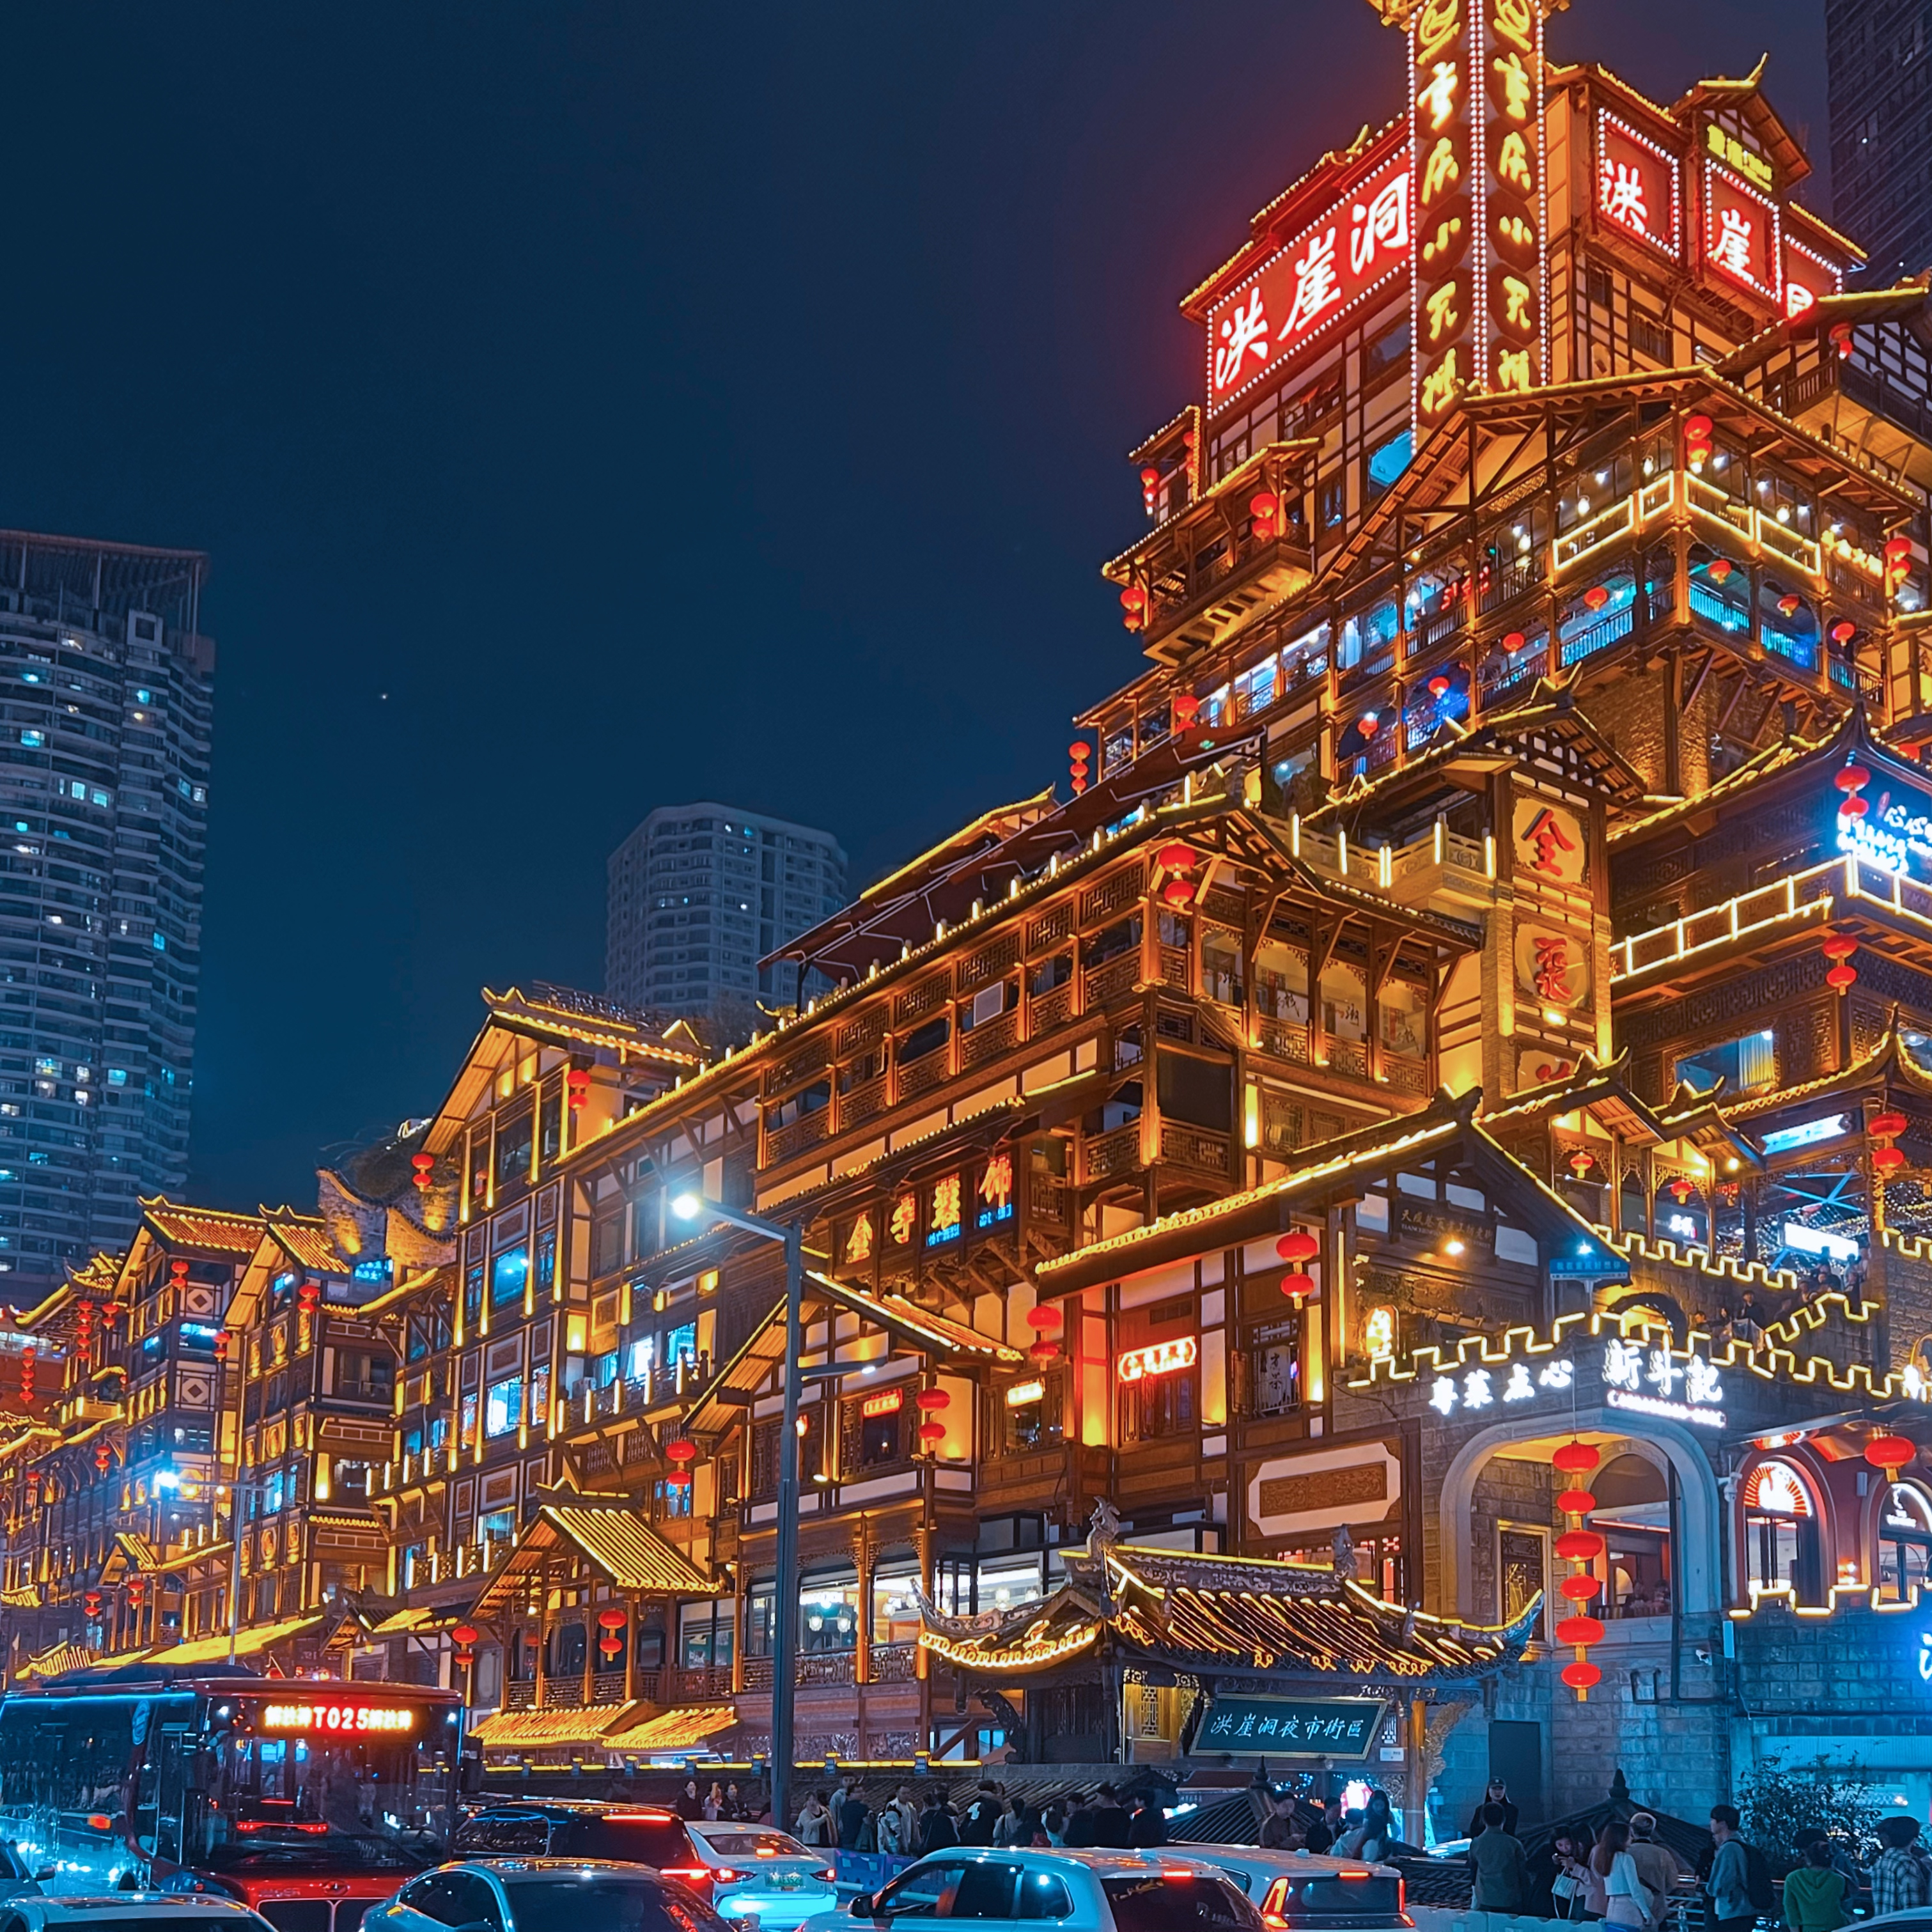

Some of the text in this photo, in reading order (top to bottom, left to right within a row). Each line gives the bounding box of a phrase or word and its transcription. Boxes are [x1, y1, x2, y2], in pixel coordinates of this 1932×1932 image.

[1215, 172, 1410, 389] 洪崖洞
[1416, 62, 1464, 413] 重庆小天鹅
[313, 1706, 370, 1730] T025
